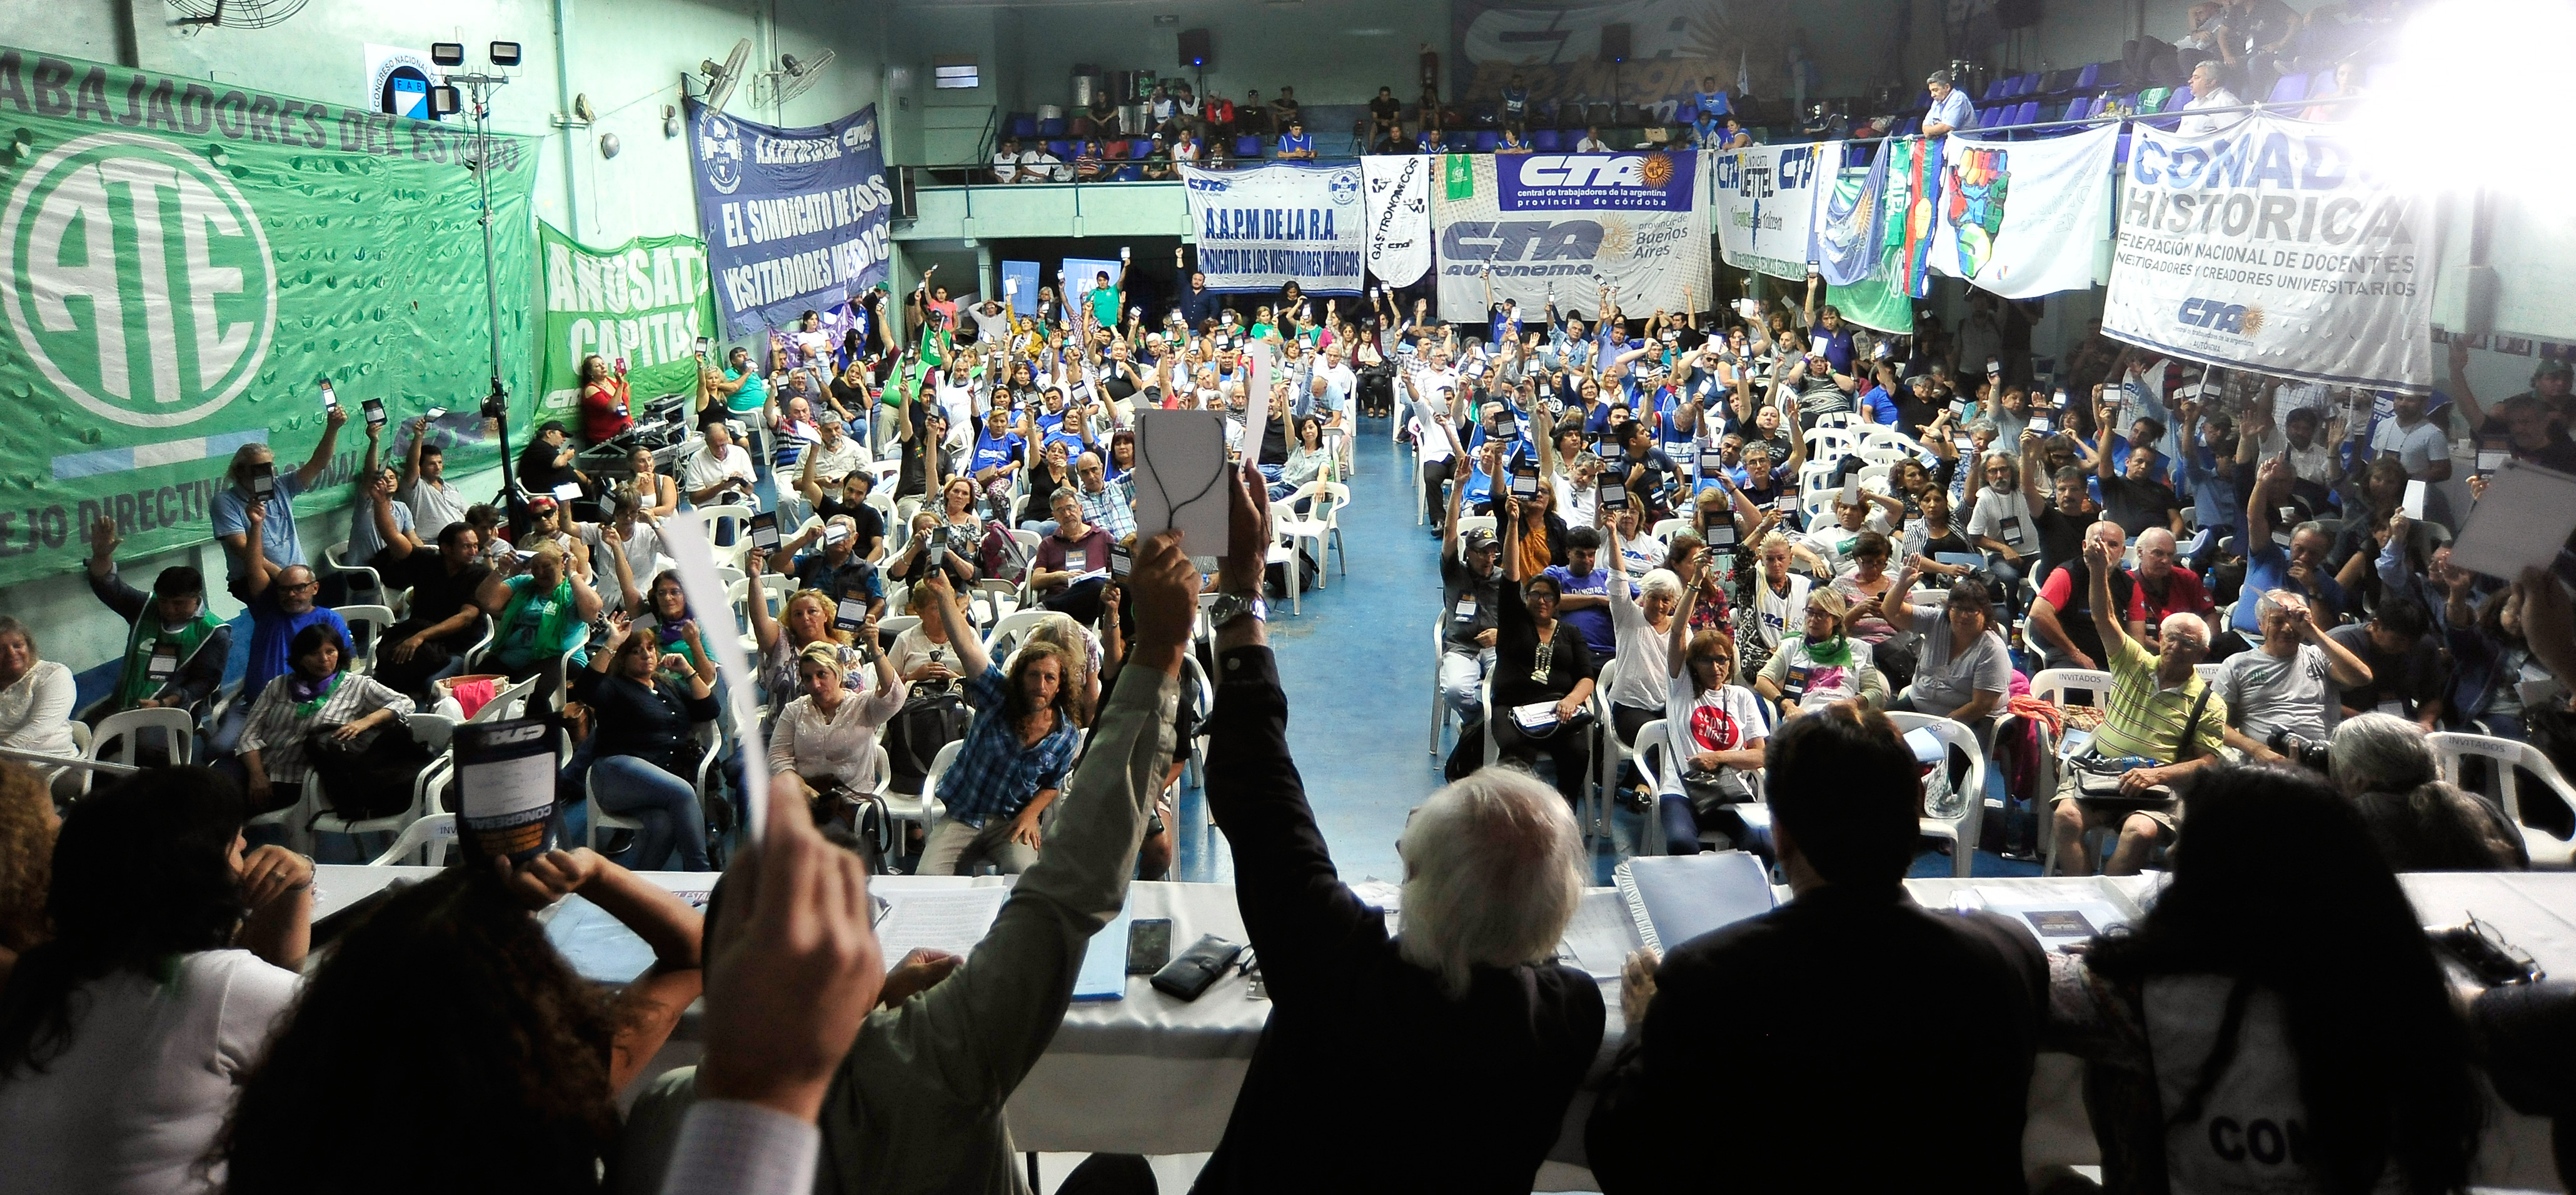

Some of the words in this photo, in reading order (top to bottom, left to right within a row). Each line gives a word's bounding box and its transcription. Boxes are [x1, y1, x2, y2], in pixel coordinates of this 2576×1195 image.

[373, 59, 395, 108] CONGRESO
[394, 55, 428, 74] NACIONAL
[429, 72, 438, 86] DE
[340, 108, 402, 157] DEL
[413, 121, 520, 172] ESTADO
[843, 124, 873, 147] CTA
[1519, 156, 1644, 187] CTA
[1717, 154, 1739, 189] CTA
[1779, 146, 1816, 190] CTA
[1517, 198, 1581, 208] provincia
[1614, 197, 1666, 206] córdoba
[1557, 188, 1607, 198] trabajadores
[1620, 188, 1628, 196] la
[1629, 189, 1666, 198] argentina
[722, 202, 749, 248] EL
[747, 191, 833, 244] SINDICATO
[832, 188, 851, 228] DE
[850, 174, 893, 222] LOS
[1205, 208, 1260, 240] A.A.P.M
[1264, 209, 1284, 241] DE
[1287, 208, 1306, 241] LA
[1310, 209, 1339, 241] R.A.
[1677, 214, 1688, 224] de
[2124, 187, 2413, 246] HISTORICA
[1442, 220, 1605, 261] CTA
[1633, 244, 1671, 259] Aires
[1636, 226, 1689, 245] Buenos
[1241, 249, 1251, 274] DE
[1253, 249, 1269, 274] LOS
[1269, 249, 1322, 277] VISITADORES
[1323, 246, 1361, 277] MÉDICOS
[2195, 243, 2268, 266] NACIONAL
[2273, 249, 2298, 269] DE
[2302, 253, 2415, 275] DOCENTES
[28, 157, 254, 403] ATE
[2194, 265, 2201, 277] Y
[2202, 266, 2274, 287] CREADORES
[2277, 274, 2416, 297] UNIVERSITARIOS
[2178, 297, 2249, 334] CTA
[2058, 673, 2101, 683] INVITADOS
[2448, 736, 2505, 752] INVITADOS
